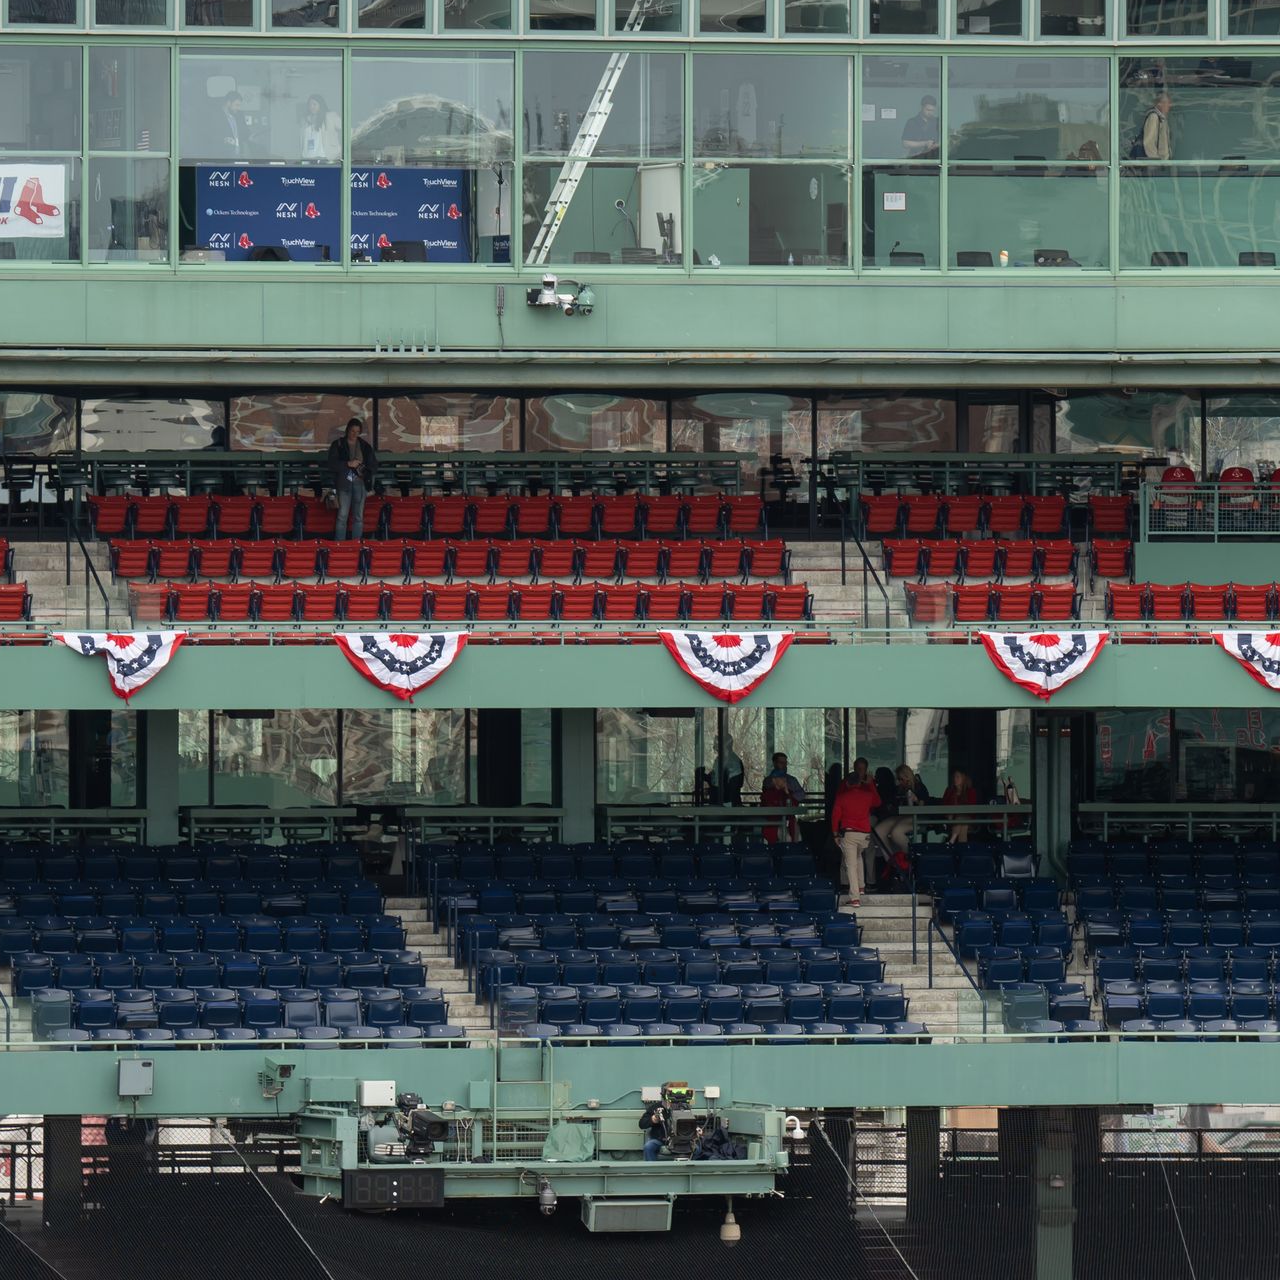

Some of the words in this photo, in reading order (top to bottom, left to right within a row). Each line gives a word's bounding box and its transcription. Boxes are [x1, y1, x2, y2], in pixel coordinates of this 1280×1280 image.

[281, 177, 315, 185] TouchView
[423, 178, 457, 187] TouchView
[281, 238, 315, 247] TouchView
[423, 239, 457, 248] TouchView
